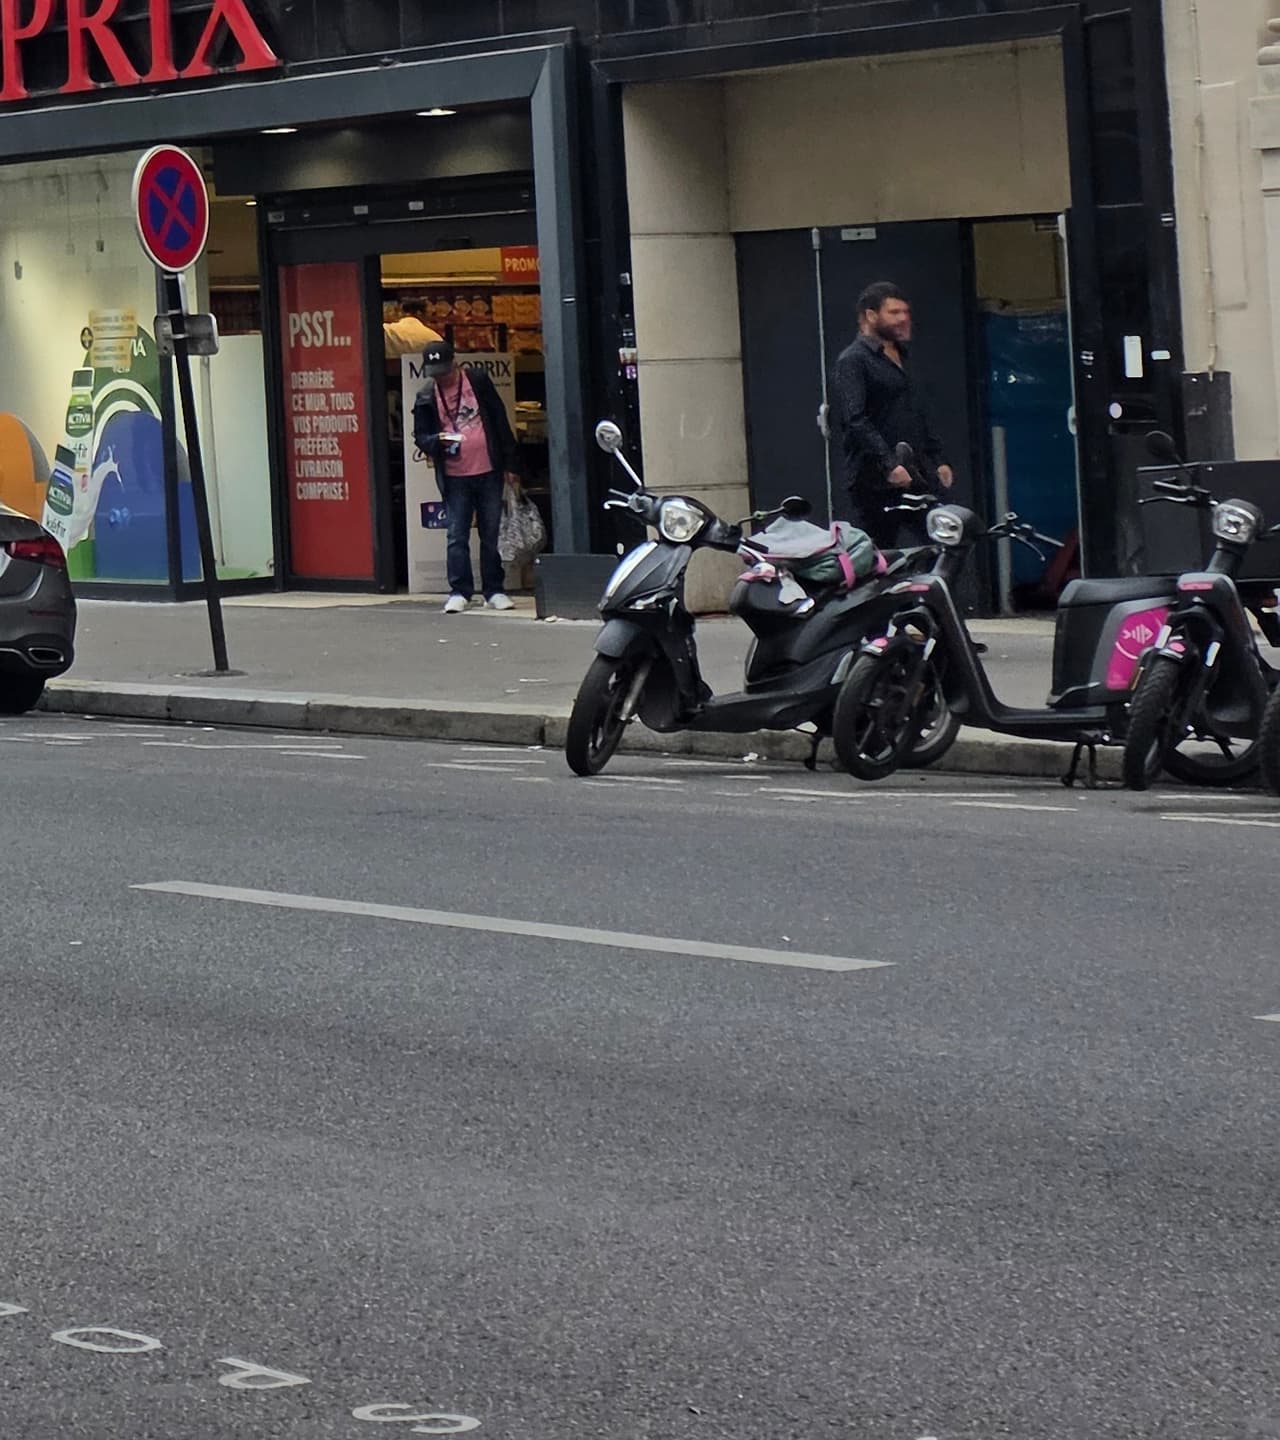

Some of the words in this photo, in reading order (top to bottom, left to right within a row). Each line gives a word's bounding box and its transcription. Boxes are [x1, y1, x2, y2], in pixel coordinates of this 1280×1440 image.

[291, 368, 335, 389] DERRIÈRE
[292, 394, 304, 411] CE
[330, 392, 355, 410] TOUS
[293, 416, 312, 434] VOS
[313, 415, 359, 434] PRODUITS
[295, 460, 344, 478] LIVRAISON
[296, 482, 344, 500] COMPRISE
